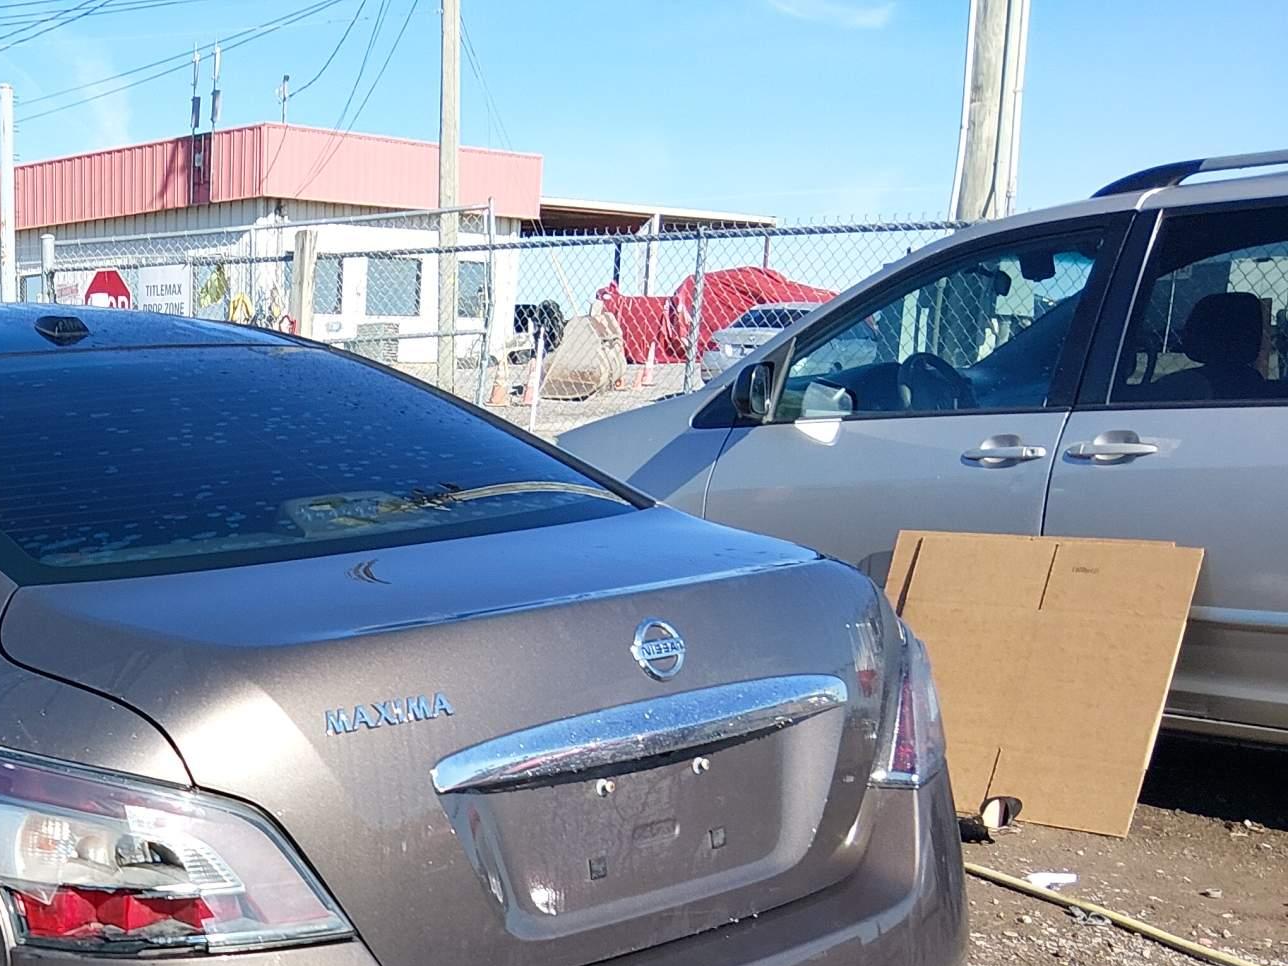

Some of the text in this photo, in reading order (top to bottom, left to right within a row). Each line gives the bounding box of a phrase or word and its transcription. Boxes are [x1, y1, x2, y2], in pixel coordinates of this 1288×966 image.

[145, 284, 182, 296] TITLEMAX
[164, 301, 185, 315] ZONE
[325, 692, 454, 736] MAXIMA
